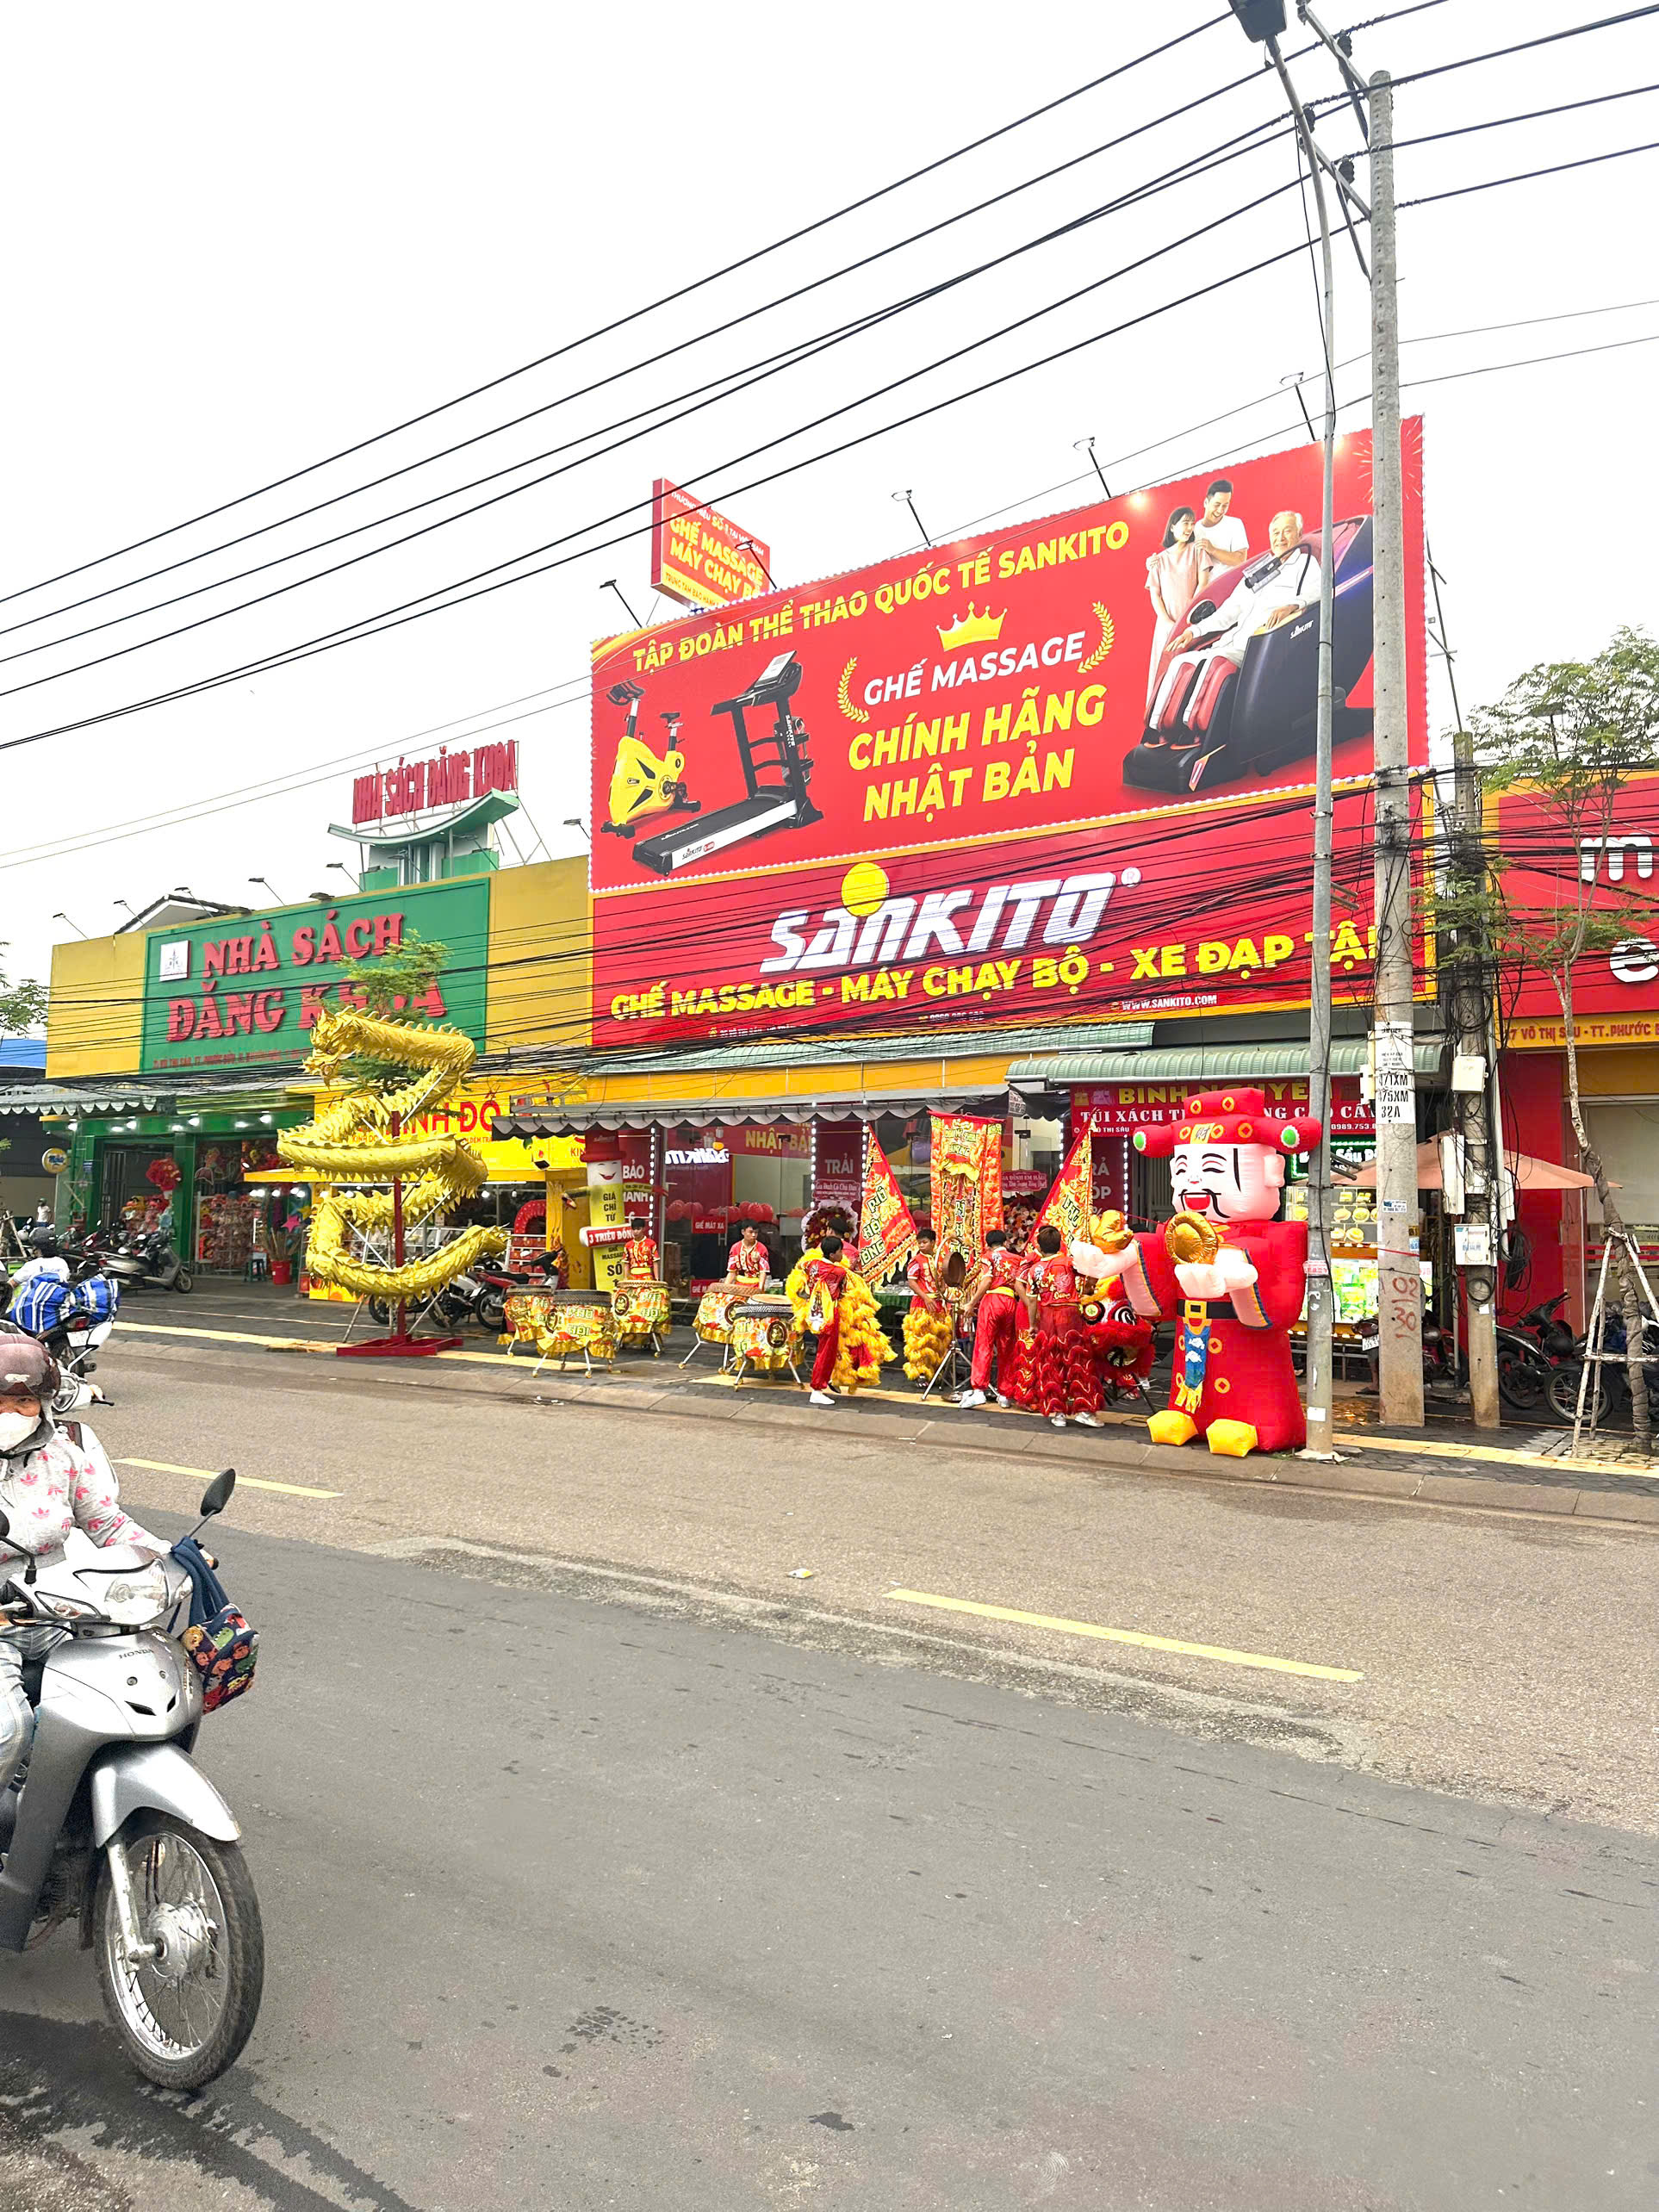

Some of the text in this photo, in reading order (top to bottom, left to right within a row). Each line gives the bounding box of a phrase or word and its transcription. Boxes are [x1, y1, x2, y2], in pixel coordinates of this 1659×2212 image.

[669, 513, 764, 587] GHẾ MASSAGE
[670, 537, 703, 570] MÁY
[705, 559, 742, 594] CHẠY
[633, 520, 1129, 675] TẬP ĐOÀN THỂ THAO QUỐC TẾ SANKITO
[863, 631, 1086, 705] GHẾ MASSAGE
[848, 683, 1108, 771] CHÍNH HÃNG
[385, 756, 426, 817] SÁCH
[474, 739, 517, 797] KHOA
[863, 740, 1075, 823] NHẬT BẢN
[202, 910, 404, 979] NHÀ SÁCH
[611, 980, 669, 1021] GHẾ
[671, 980, 817, 1016] MASSAGE
[841, 966, 915, 1003] MÁY
[923, 960, 1022, 1001] CHẠY
[1032, 945, 1089, 995] BỘ
[1129, 944, 1187, 980] XE
[1196, 935, 1295, 980] ĐẠP
[166, 979, 286, 1042] ĐĂNG
[1122, 994, 1217, 1010] WWW.SANKITO.COM
[1521, 1026, 1536, 1040] VÕ
[1559, 1025, 1581, 1039] SU
[1080, 1108, 1110, 1123] TÚI
[1115, 1108, 1164, 1122] XÁCH
[570, 1147, 586, 1157] KIN
[623, 1159, 645, 1179] BẢO
[1092, 1157, 1110, 1176] RẢ
[603, 1191, 616, 1202] GIÁ
[1092, 1183, 1112, 1200] ÓP
[717, 1221, 724, 1230] XA
[589, 1233, 593, 1244] 3
[606, 1260, 623, 1277] SỐ
[119, 1648, 155, 1659] HONDA
